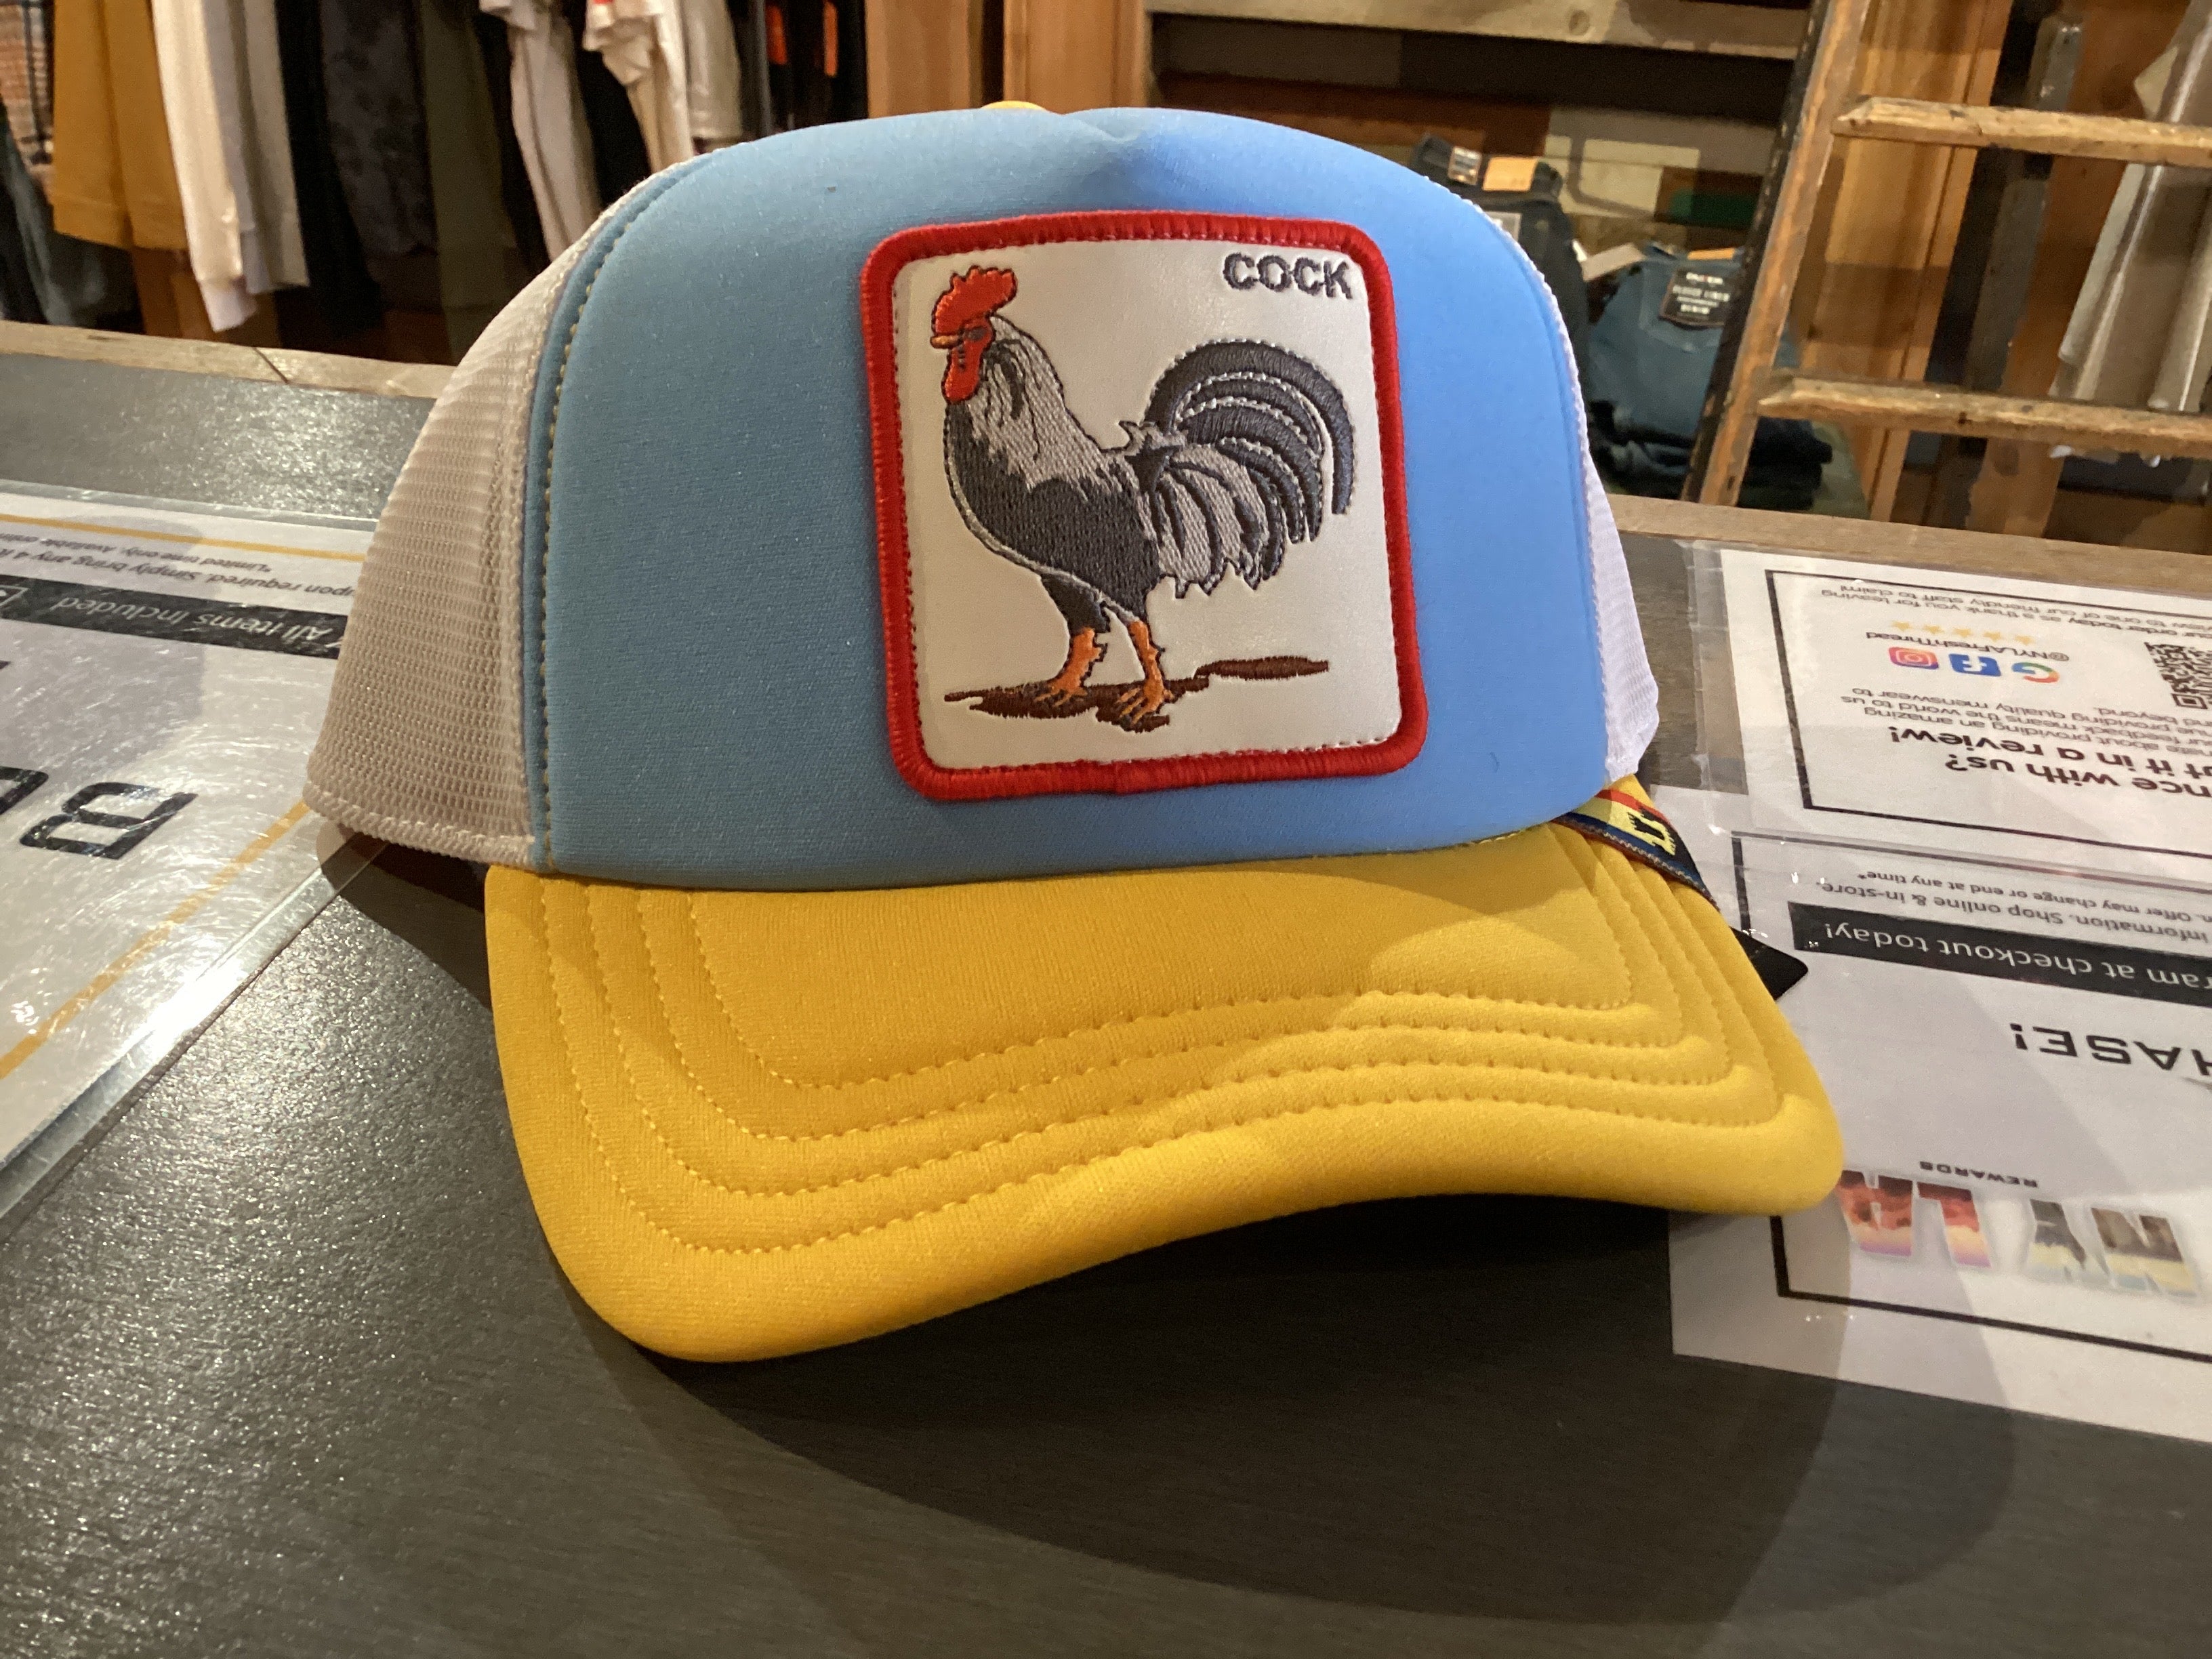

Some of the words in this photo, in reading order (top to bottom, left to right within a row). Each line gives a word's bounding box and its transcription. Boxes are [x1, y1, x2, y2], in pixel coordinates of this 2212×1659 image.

[1223, 251, 1352, 298] COCK
[49, 597, 189, 625] Included
[192, 613, 284, 636] Items
[282, 624, 333, 643] All
[1841, 696, 1866, 705] us
[1852, 688, 1874, 697] to
[1878, 691, 1988, 709] menswear
[1872, 699, 1892, 709] to
[1898, 702, 1961, 716] world
[1996, 703, 2065, 719] quality
[1864, 707, 1953, 726] amazing
[1959, 719, 1985, 729] an
[1965, 710, 2000, 721] the
[2072, 713, 2170, 732] providing
[1888, 726, 2045, 756] review!
[1992, 722, 2092, 743] providing
[2057, 747, 2085, 760] a
[2096, 752, 2136, 771] in
[1945, 754, 2015, 773] us?
[2146, 758, 2175, 777] it
[2025, 763, 2120, 787] with
[1911, 875, 1943, 888] any
[1948, 881, 1965, 891] at
[1970, 884, 2004, 896] end
[1816, 882, 1906, 904] in-store.
[1911, 893, 1927, 907] &
[2009, 889, 2028, 899] or
[2032, 891, 2097, 909] change
[1933, 897, 2001, 914] online
[2102, 900, 2139, 915] may
[2146, 907, 2191, 922] Offer
[2007, 905, 2064, 926] Shop
[1824, 922, 1929, 952] today!
[2068, 914, 2209, 944] information.
[1937, 940, 2093, 975] checkout
[2101, 962, 2135, 979] at
[1919, 1162, 2038, 1188] REWARDS
